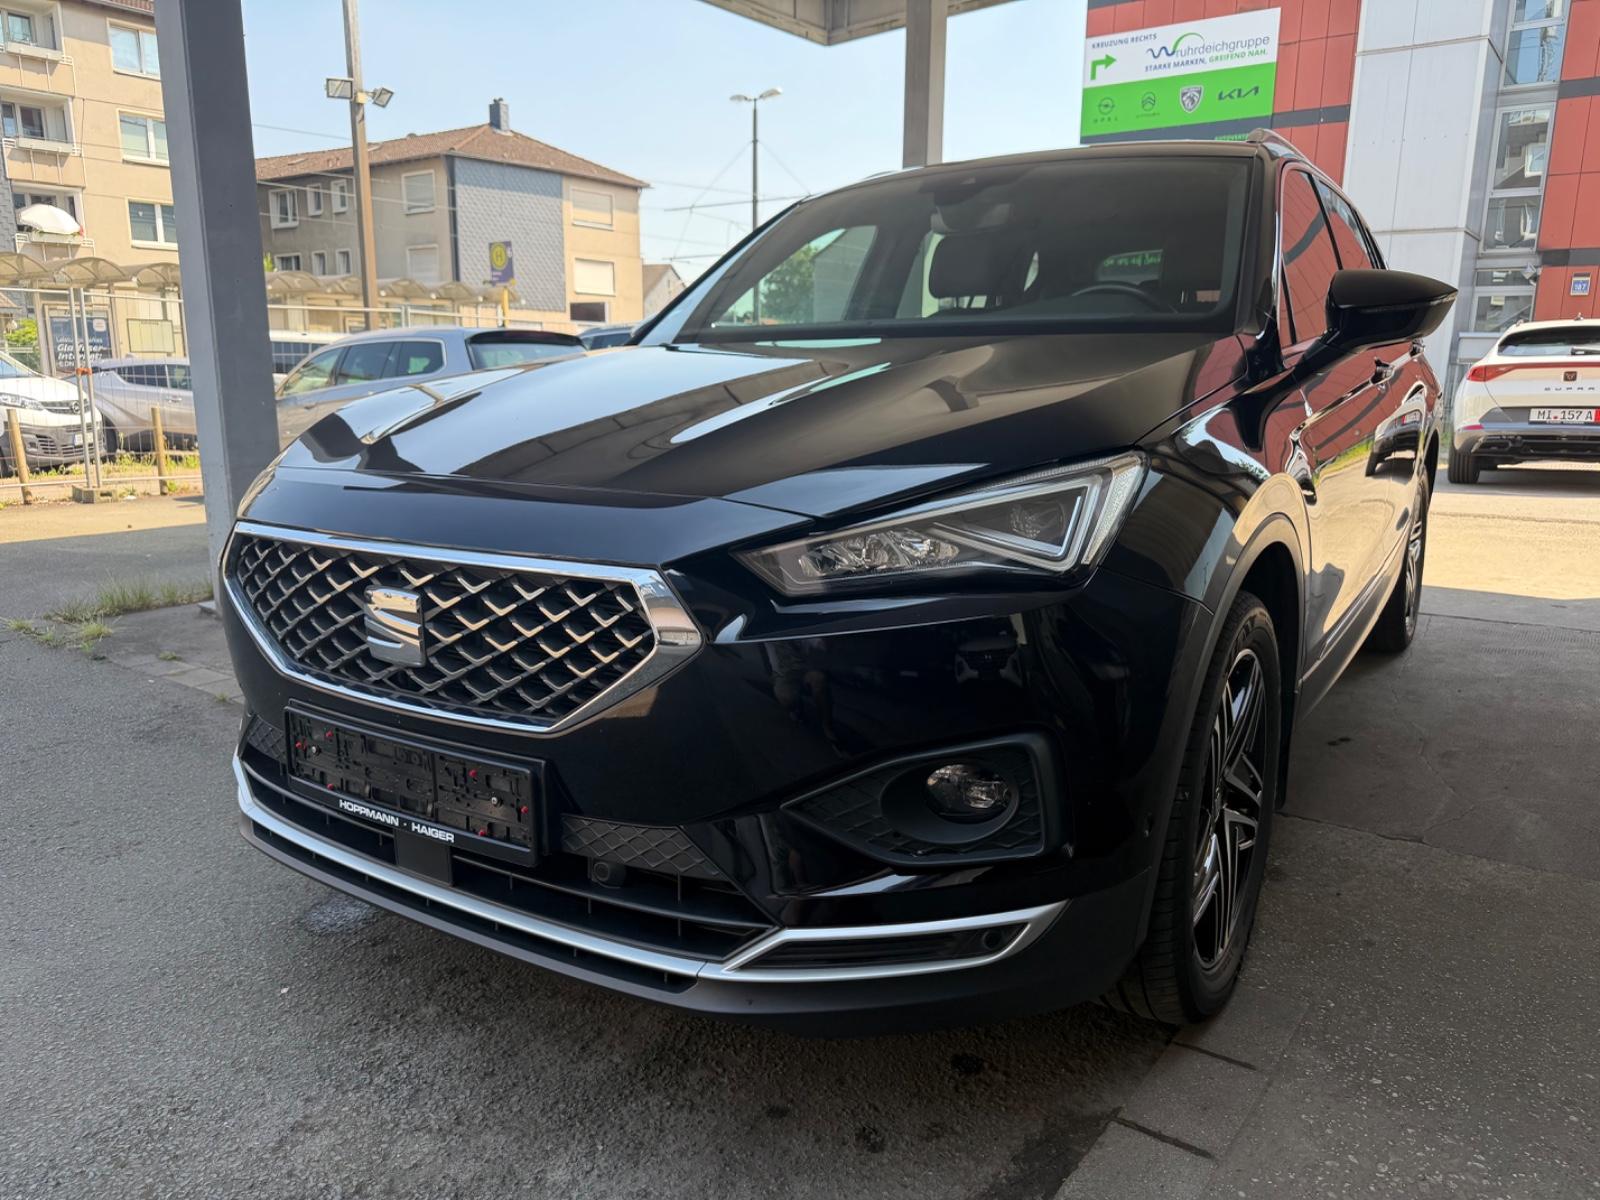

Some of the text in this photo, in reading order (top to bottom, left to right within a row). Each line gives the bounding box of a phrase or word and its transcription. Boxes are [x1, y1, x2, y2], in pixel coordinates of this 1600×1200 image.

[1092, 33, 1157, 49] KREUZUNG RECHTS
[1175, 36, 1270, 57] ruhrdeichgruppe
[1145, 61, 1171, 72] STARKE
[1209, 53, 1246, 63] GREIFEND
[1218, 86, 1260, 101] KIA
[339, 798, 455, 844] HOPPMANN HAIGER
